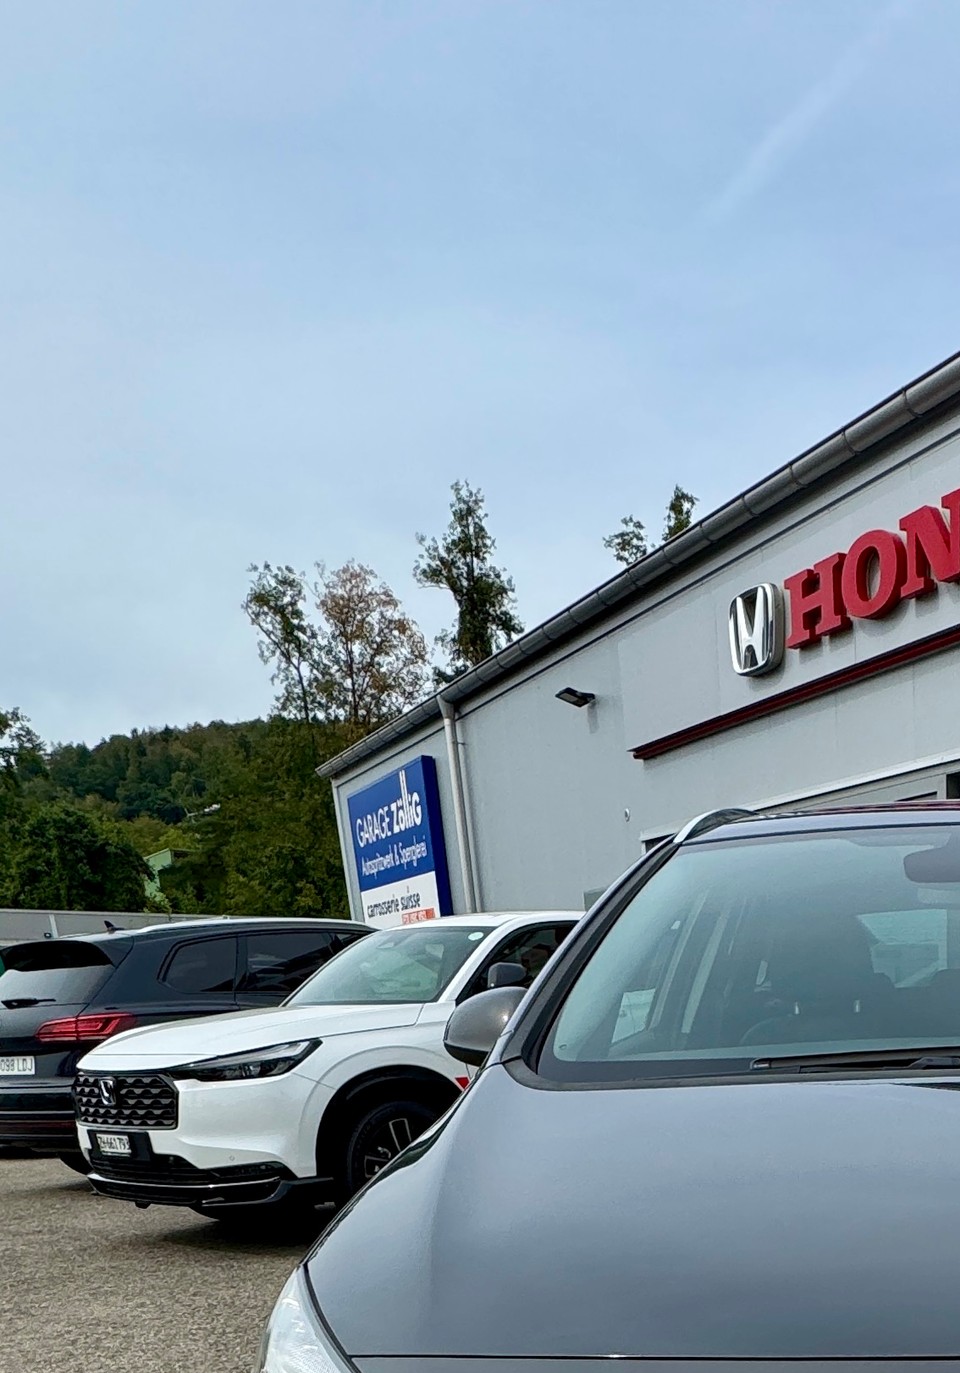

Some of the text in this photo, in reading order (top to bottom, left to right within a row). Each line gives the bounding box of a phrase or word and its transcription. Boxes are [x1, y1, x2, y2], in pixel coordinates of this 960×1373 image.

[356, 805, 392, 848] GARAGE
[394, 844, 400, 866] &
[366, 893, 400, 918] carrosserie
[400, 885, 421, 911] suisse
